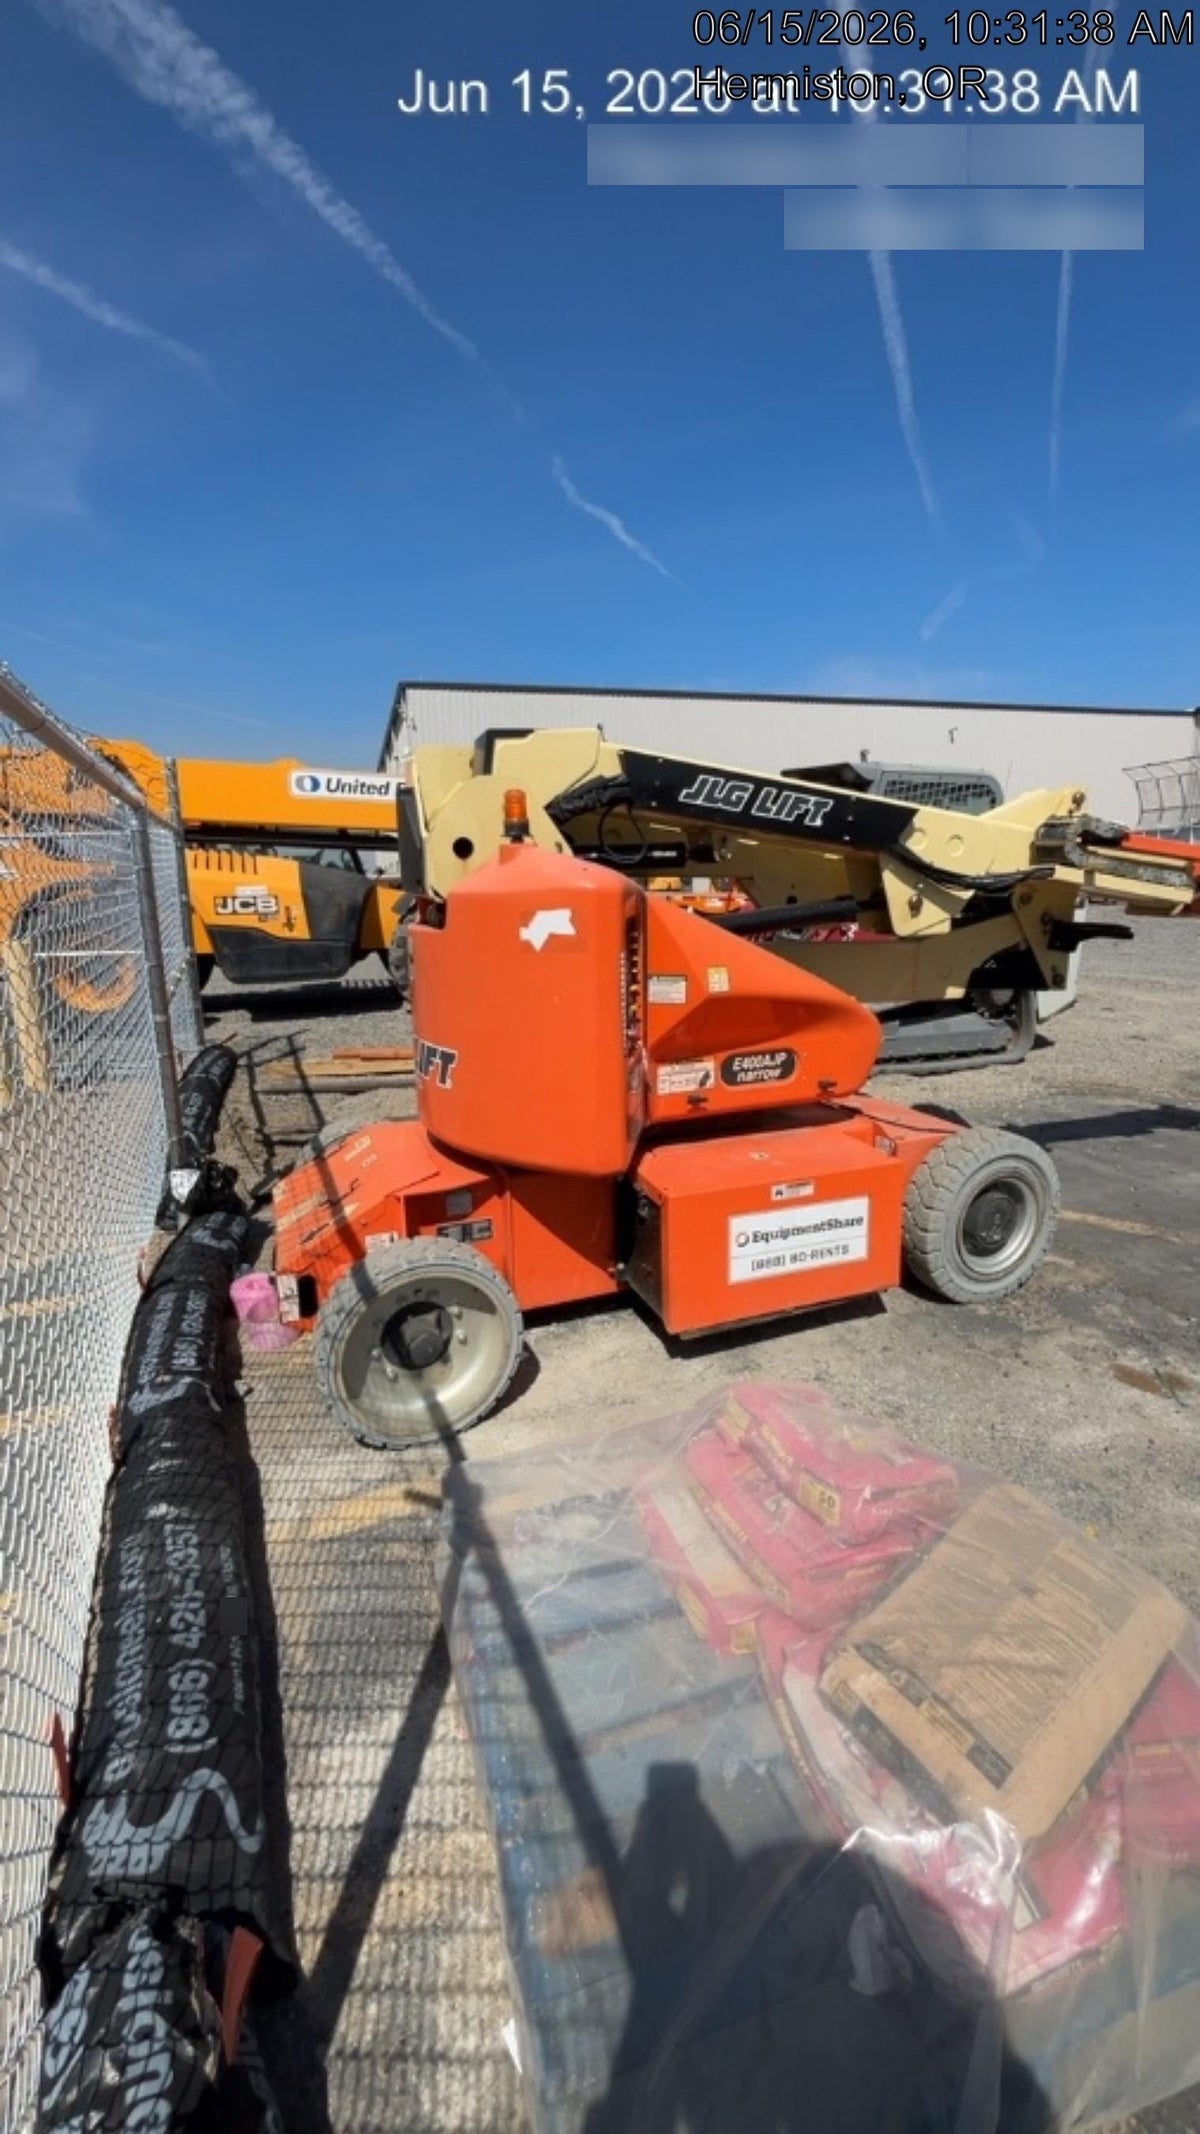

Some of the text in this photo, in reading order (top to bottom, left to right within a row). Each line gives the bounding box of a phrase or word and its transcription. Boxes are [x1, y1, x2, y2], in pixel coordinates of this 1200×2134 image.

[326, 777, 391, 796] United
[678, 774, 834, 827] JLG LIFT
[215, 897, 278, 914] JCB
[751, 1216, 864, 1243] EquipmentShare
[163, 1659, 218, 1753] (866)
